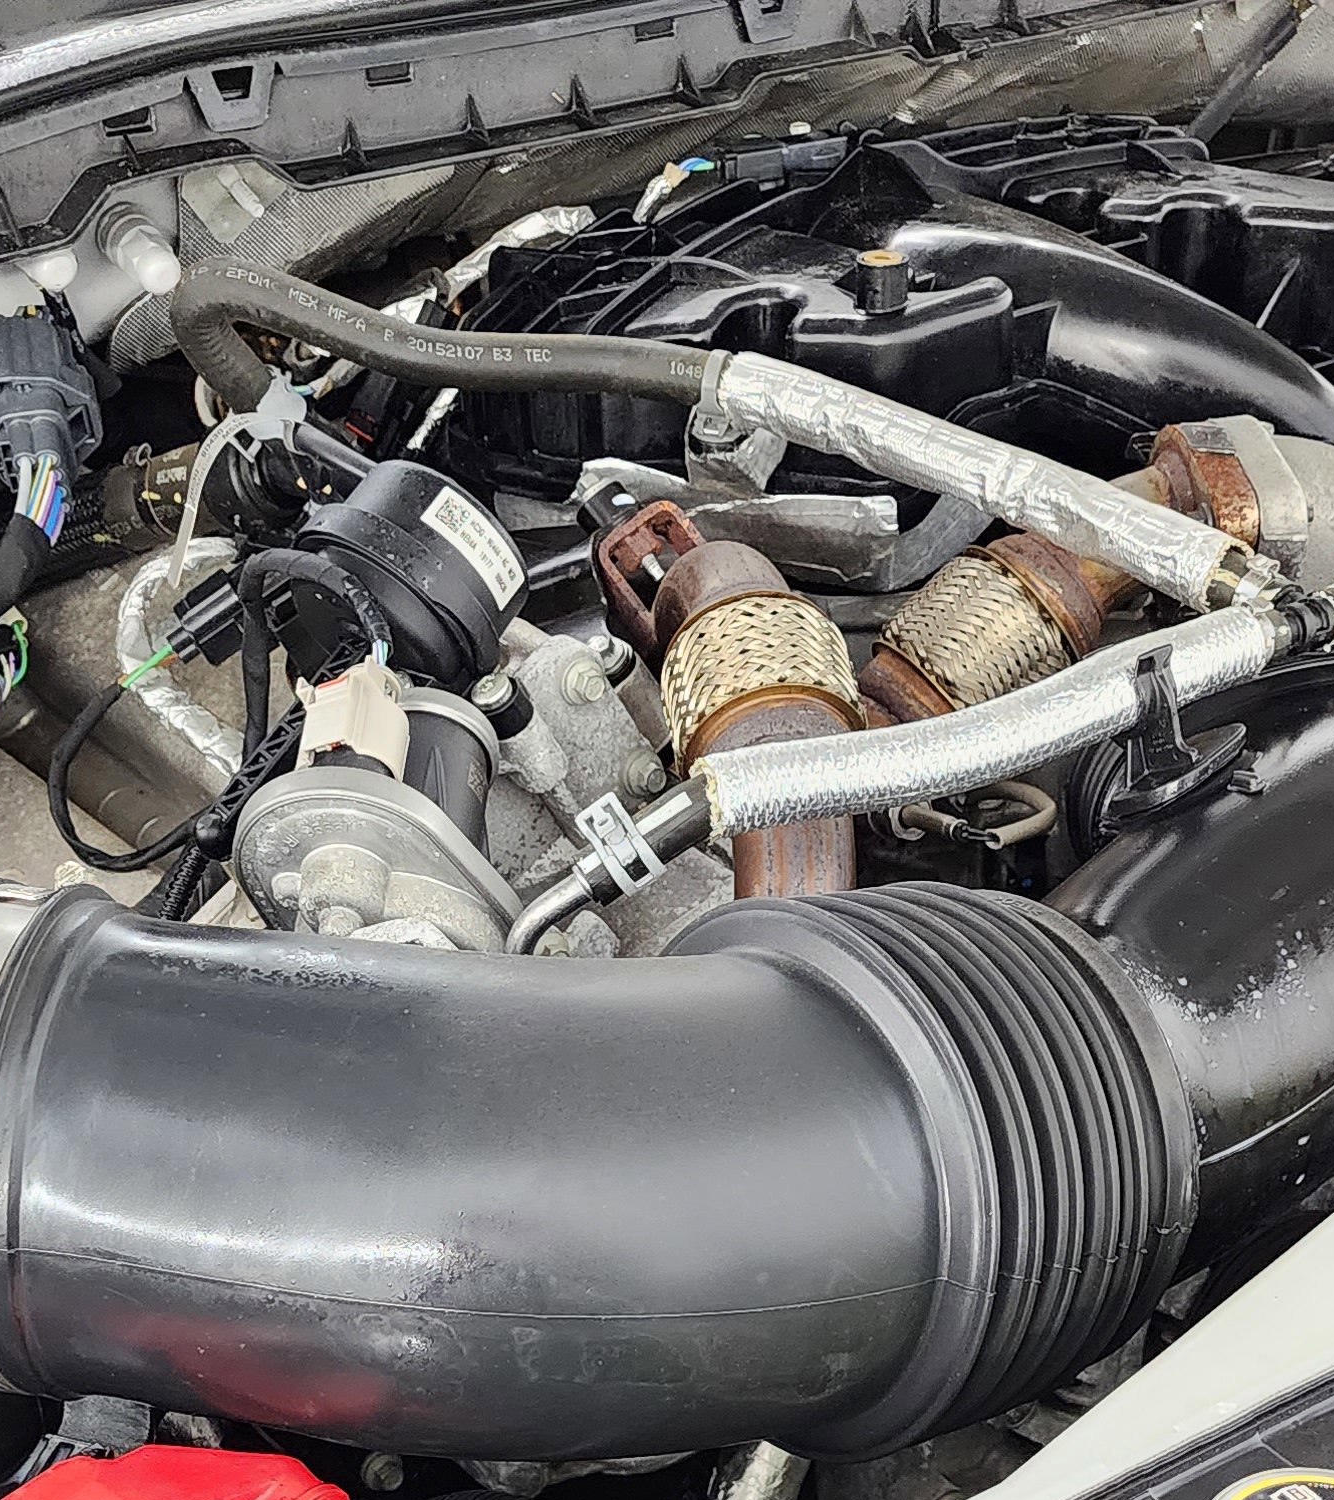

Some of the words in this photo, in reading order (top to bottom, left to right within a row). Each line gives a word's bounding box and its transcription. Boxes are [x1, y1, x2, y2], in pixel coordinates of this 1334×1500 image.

[288, 287, 319, 310] MEX
[524, 348, 552, 363] TEC
[669, 360, 703, 379] 1048
